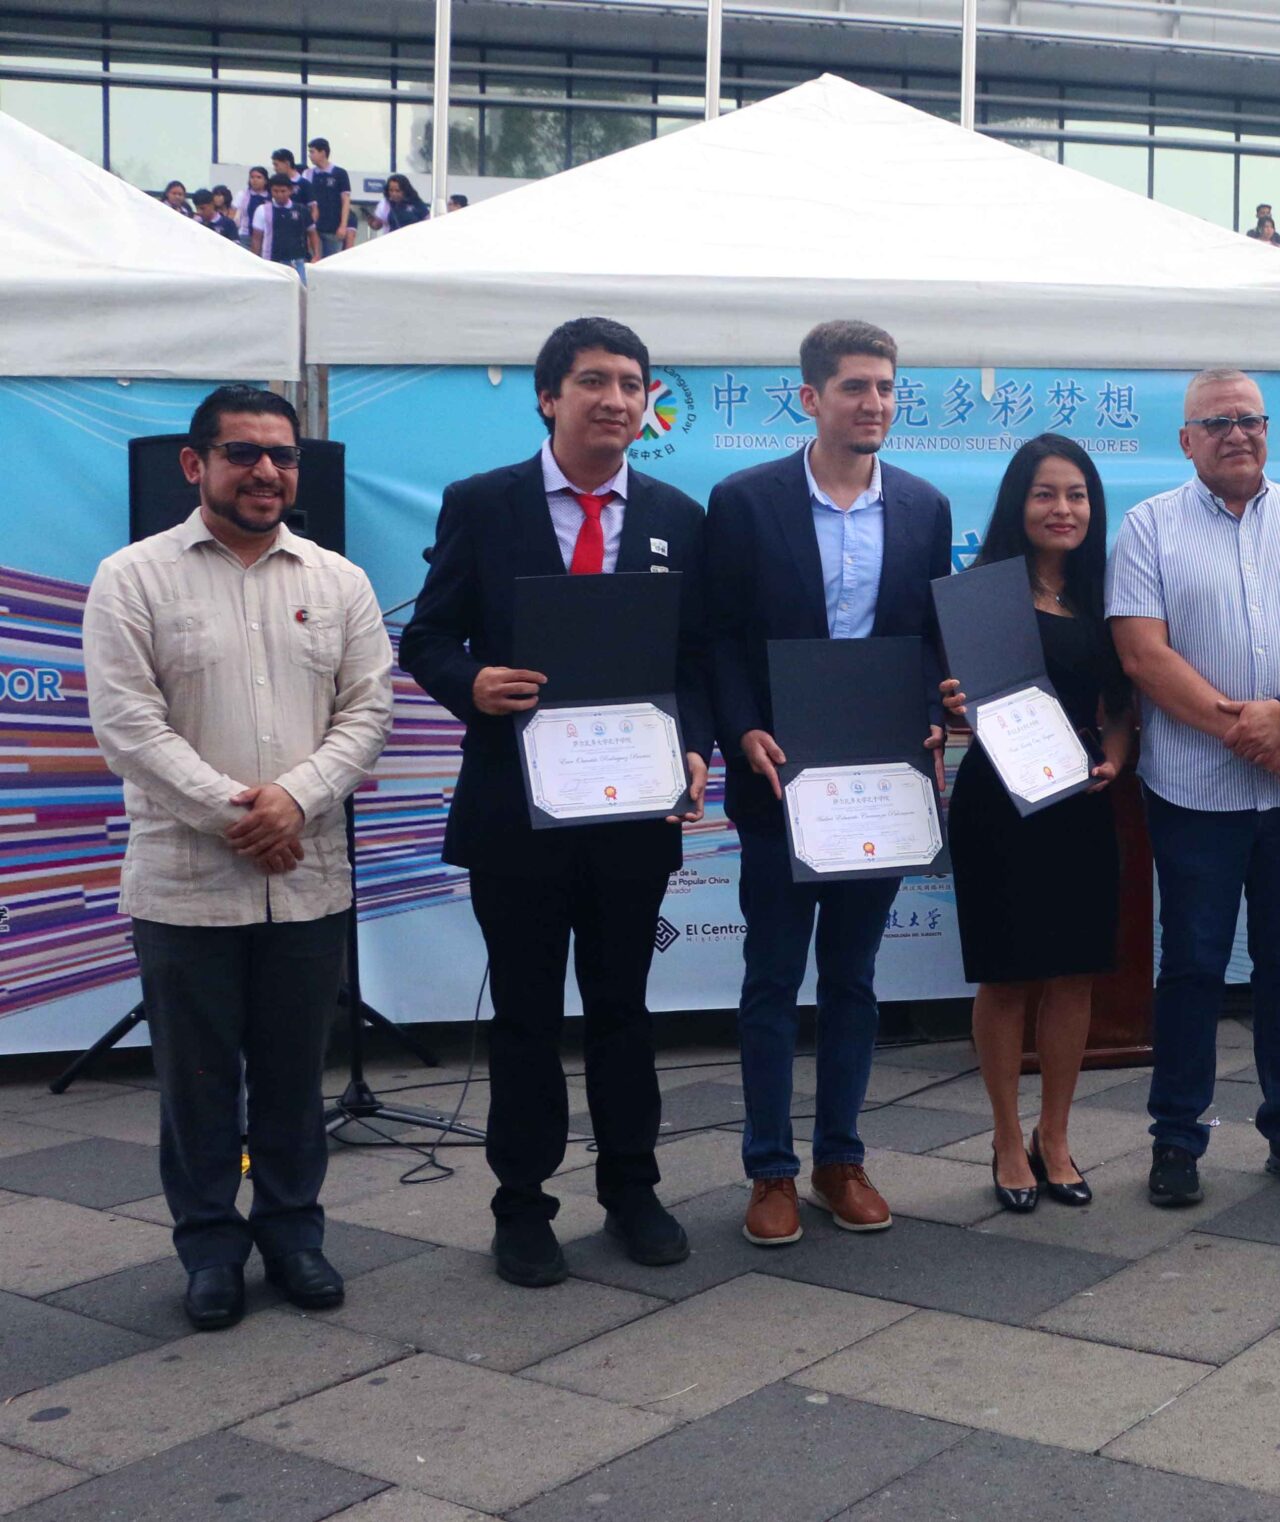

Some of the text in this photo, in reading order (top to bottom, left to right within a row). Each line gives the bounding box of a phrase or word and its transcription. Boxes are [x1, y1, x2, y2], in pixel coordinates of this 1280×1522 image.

[682, 413, 697, 434] Day
[627, 443, 676, 461] 际中文日
[715, 435, 777, 448] IDIOMA
[881, 436, 960, 450] MINANDO
[1074, 438, 1138, 452] OLORES
[678, 877, 707, 887] Popular
[708, 876, 730, 885] China
[680, 869, 689, 877] de
[885, 908, 942, 930] 技大学
[686, 923, 748, 936] El Centro
